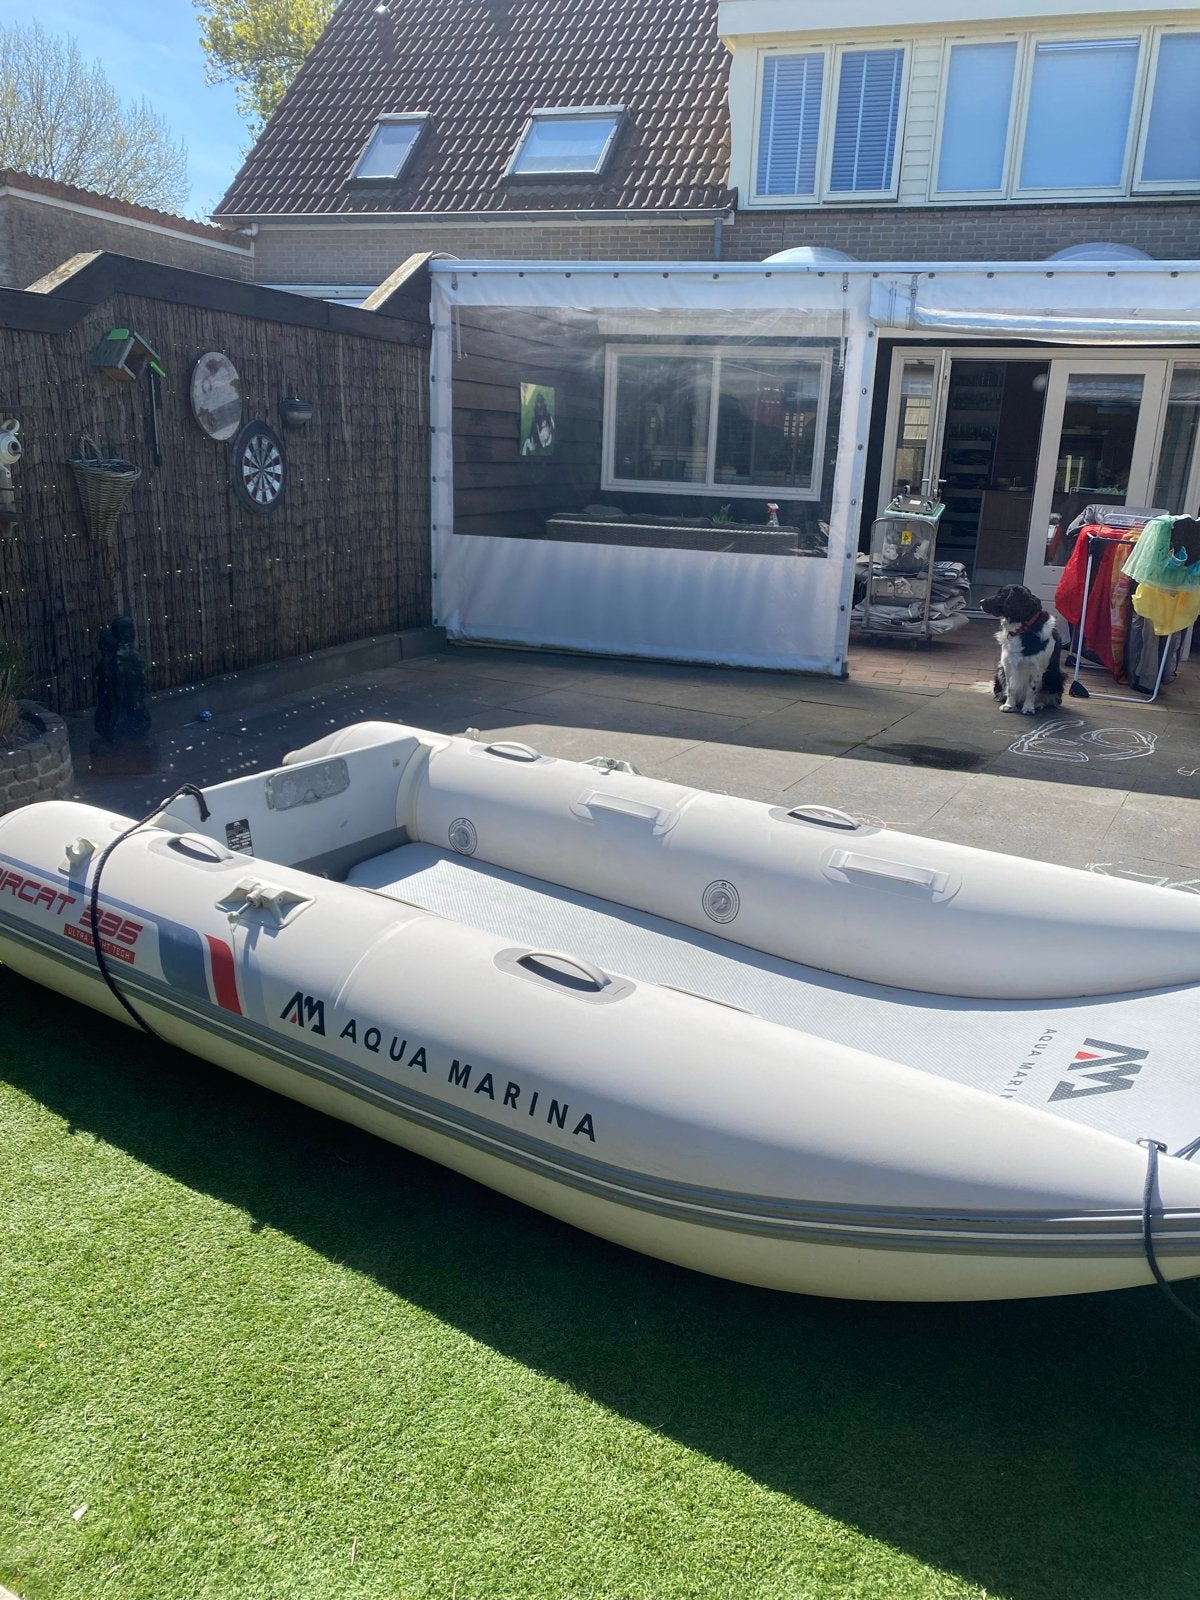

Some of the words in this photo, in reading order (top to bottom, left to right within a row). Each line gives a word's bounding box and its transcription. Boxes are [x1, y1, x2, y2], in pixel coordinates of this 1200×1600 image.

[0, 867, 77, 915] IRCAT
[79, 904, 144, 945] 335
[67, 926, 88, 942] ULTRA
[90, 935, 111, 951] LHT
[112, 946, 131, 960] TECH
[1028, 1028, 1057, 1057] AQUA
[340, 1018, 428, 1073] AQUA
[447, 1059, 596, 1143] MARINA
